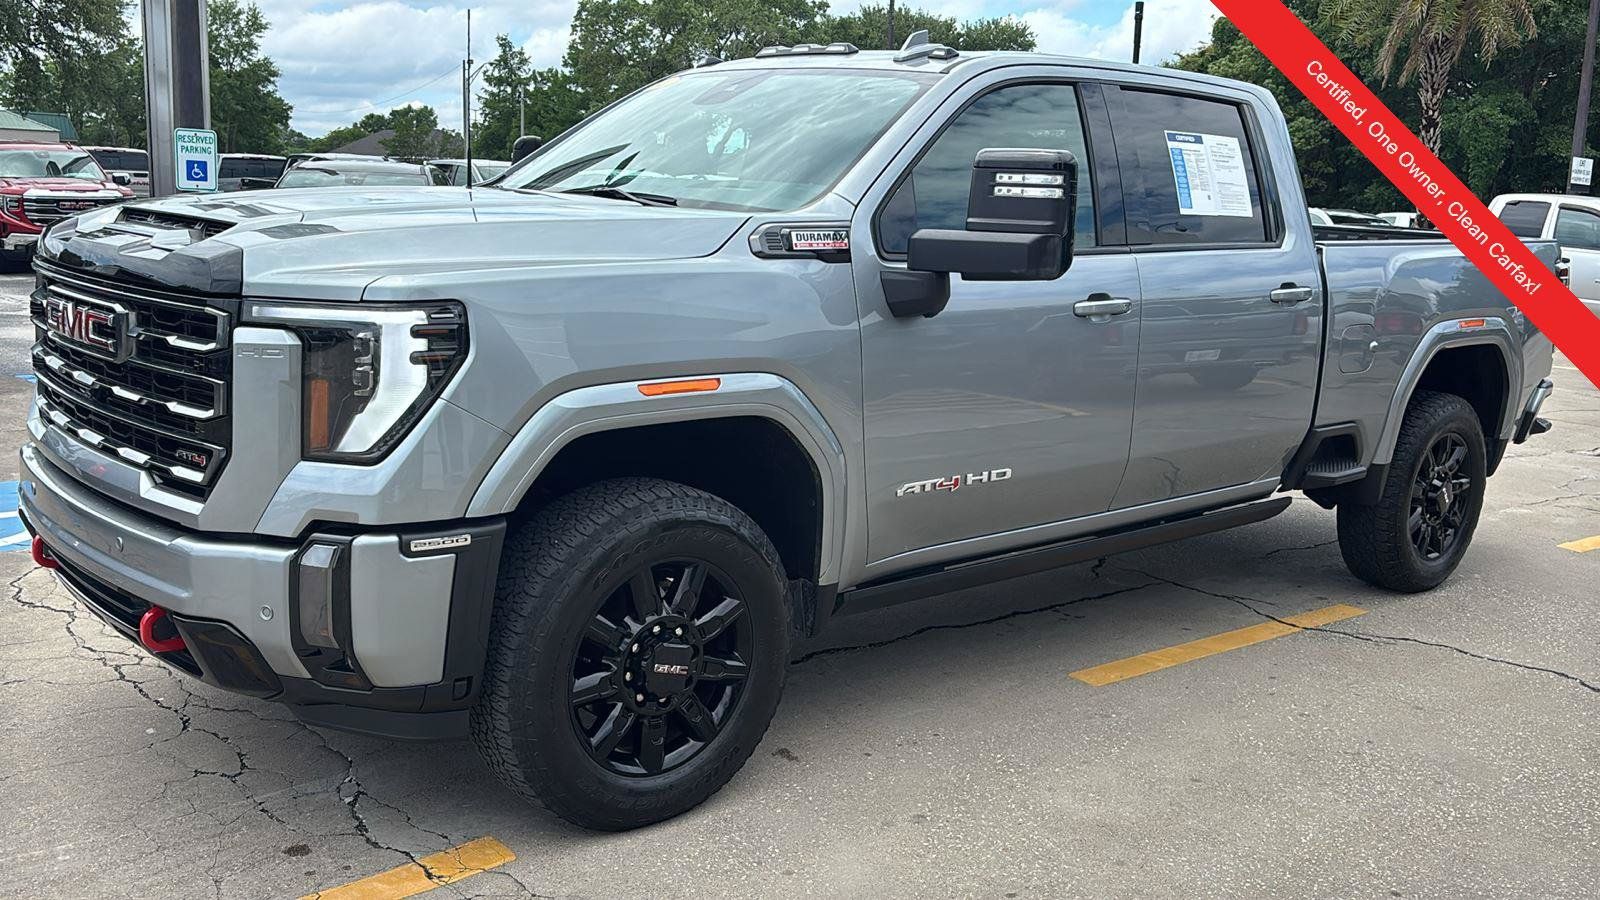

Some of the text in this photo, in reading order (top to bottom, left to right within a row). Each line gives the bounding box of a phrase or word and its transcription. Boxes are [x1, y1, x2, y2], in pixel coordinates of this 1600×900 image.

[177, 134, 214, 145] RESERVED
[180, 145, 212, 155] PARKING
[795, 232, 845, 242] DURAMAX
[46, 296, 115, 352] GMC
[175, 449, 206, 467] AT4
[896, 467, 1012, 497] AT4 HD
[410, 534, 471, 552] 2500
[653, 663, 689, 675] GMC
